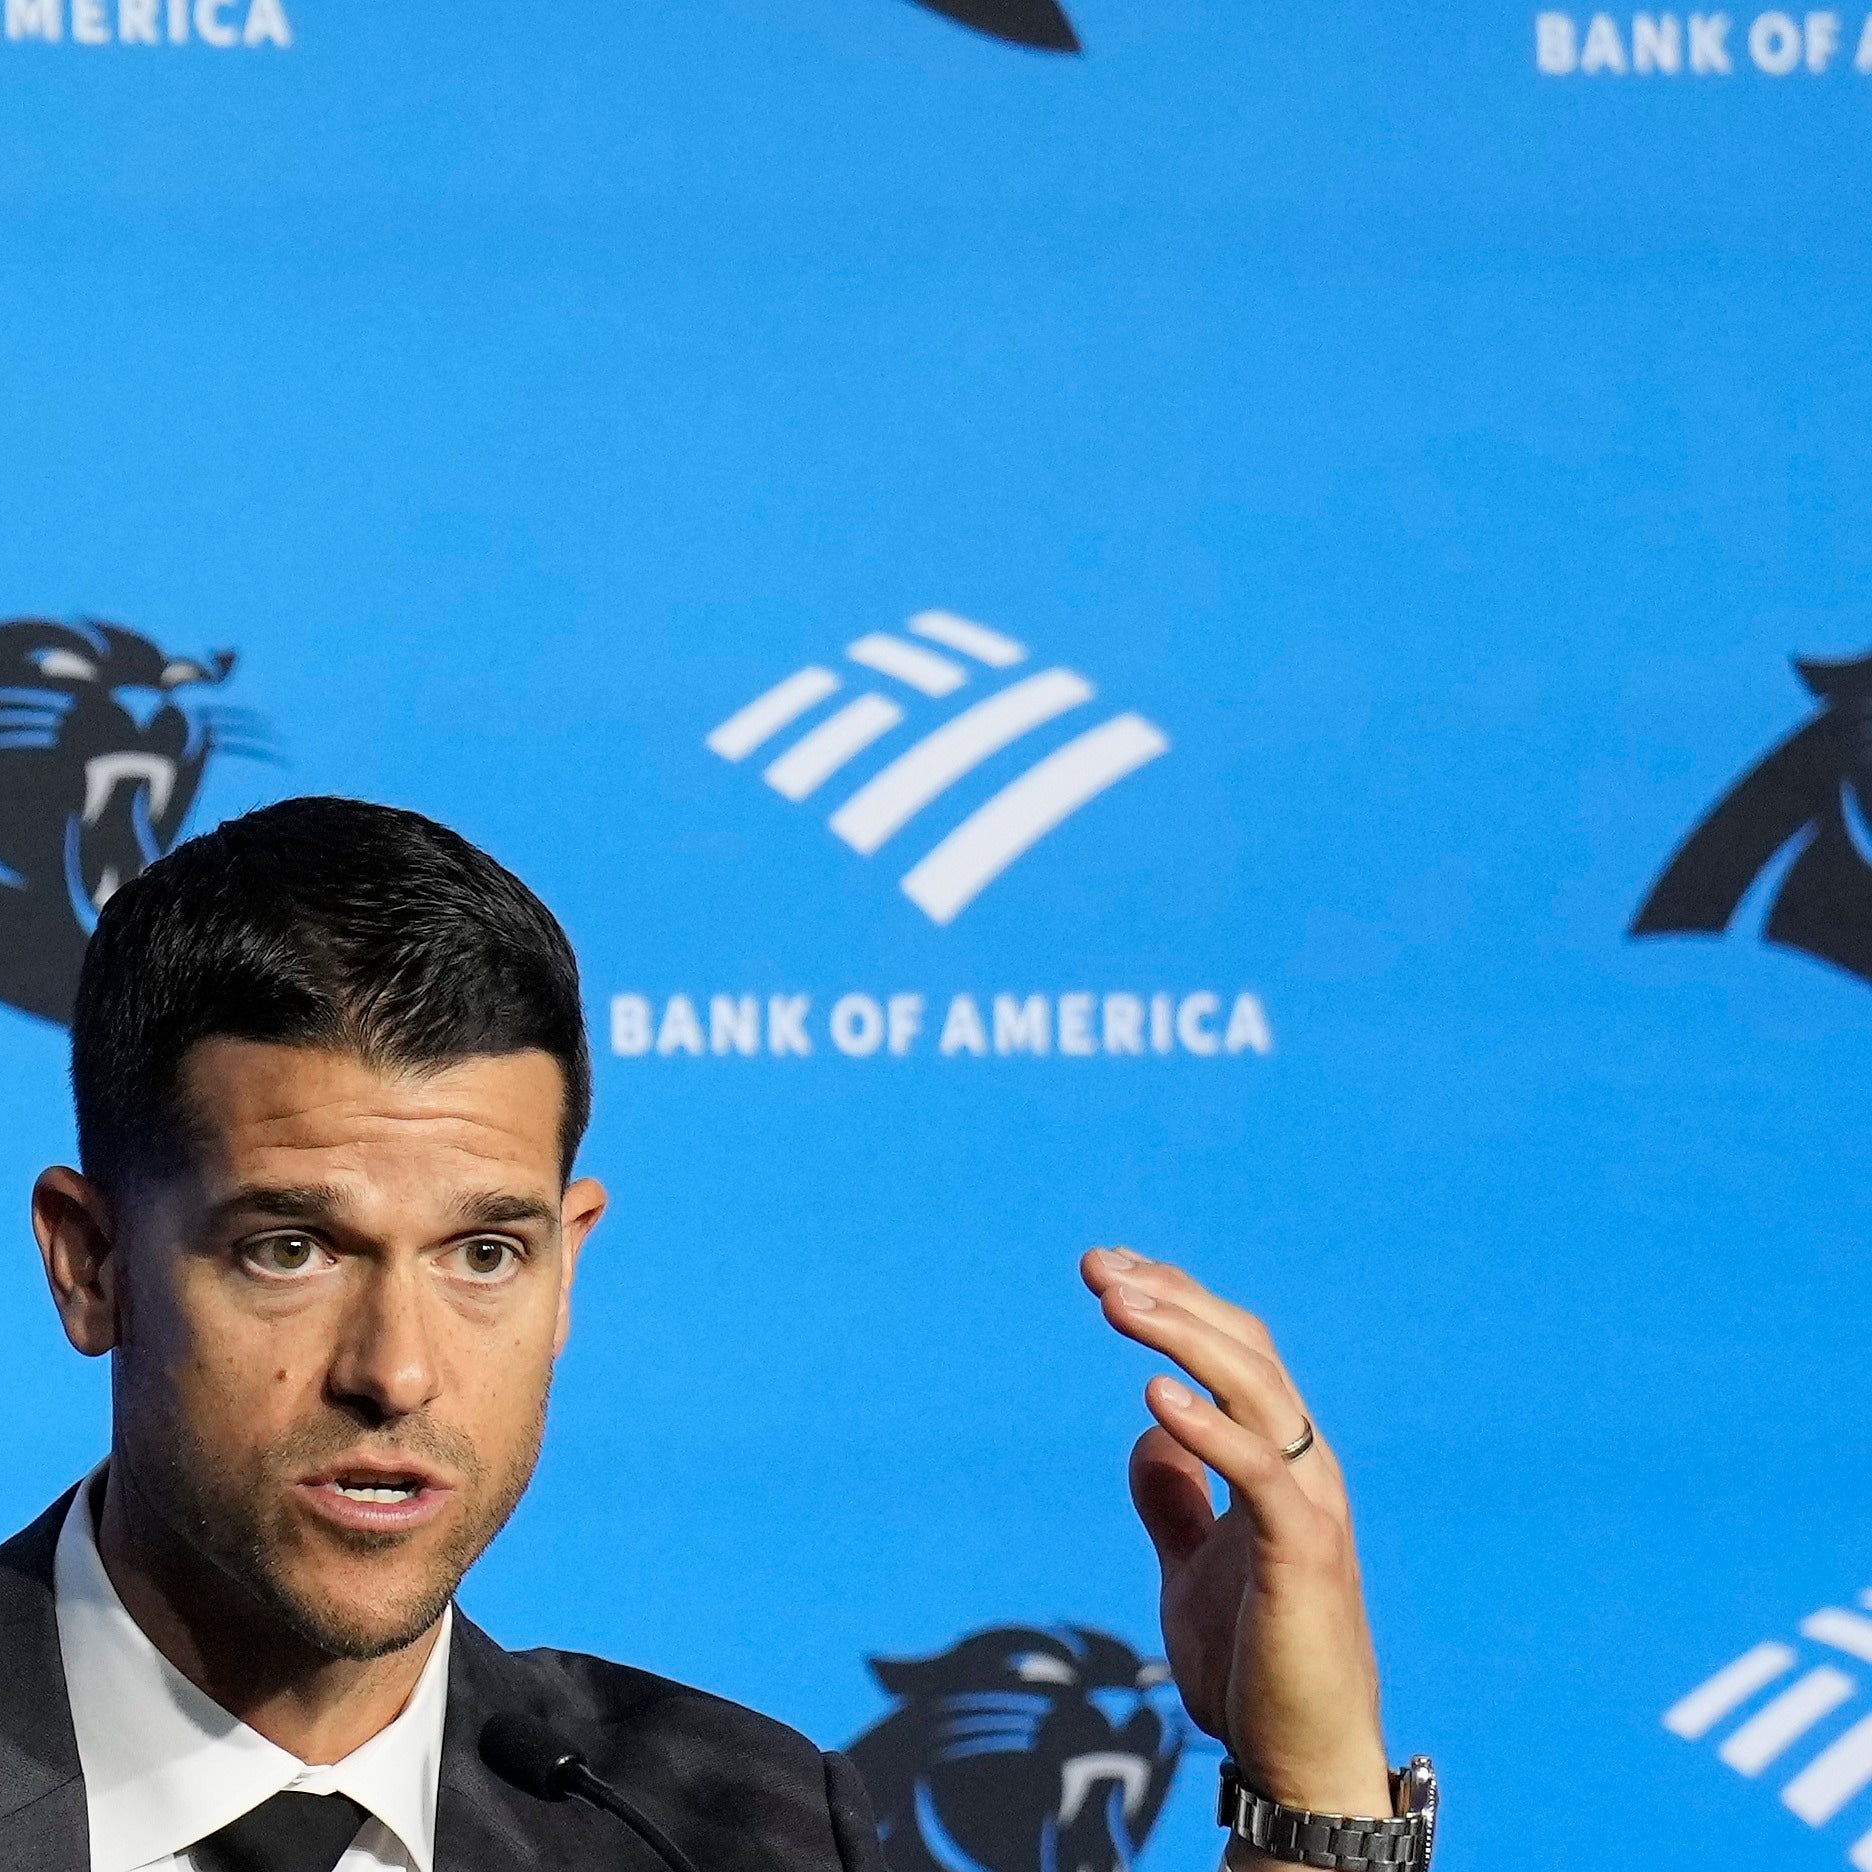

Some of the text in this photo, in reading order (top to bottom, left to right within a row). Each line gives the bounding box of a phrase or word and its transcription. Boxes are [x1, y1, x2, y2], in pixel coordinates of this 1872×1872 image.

[1535, 11, 1733, 76] BANK
[1748, 10, 1840, 76] OF
[609, 990, 1274, 1058] BANK OF AMERICA
